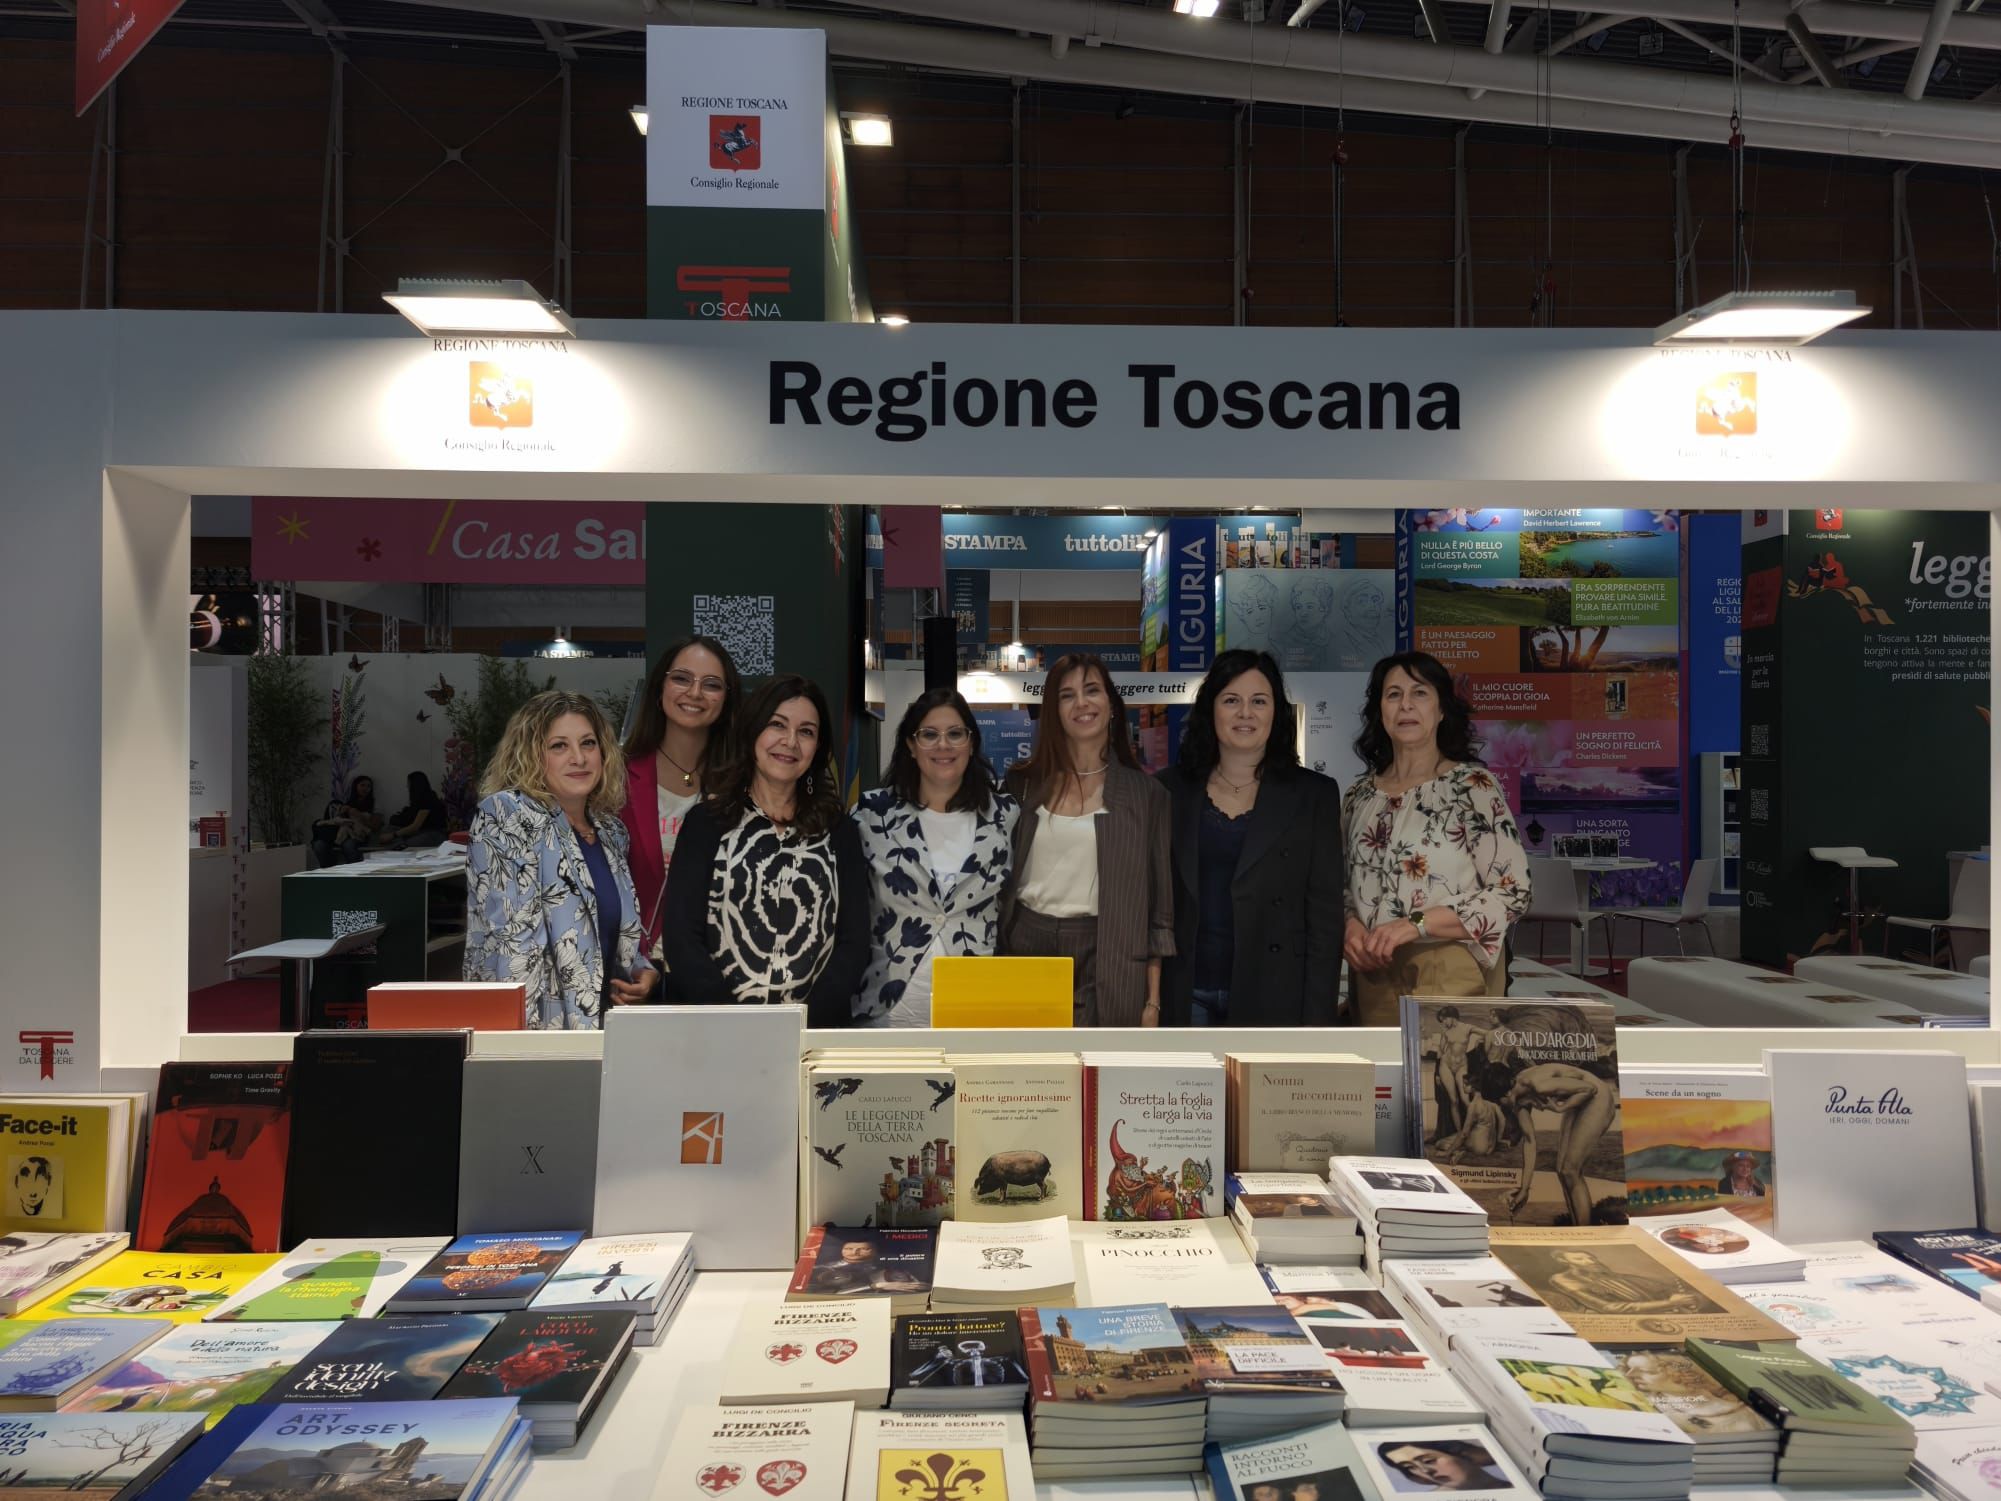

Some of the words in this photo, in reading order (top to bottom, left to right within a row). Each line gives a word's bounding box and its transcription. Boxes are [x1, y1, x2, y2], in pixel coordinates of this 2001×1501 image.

[681, 97, 733, 109] REGIONE
[736, 98, 788, 111] TOSCANA
[690, 177, 733, 191] Consiglio
[735, 178, 780, 191] Regionale
[686, 301, 782, 318] TOSCANA
[769, 360, 1097, 442] Regione
[1128, 364, 1460, 430] Toscana
[1523, 508, 1582, 517] IMPORTANTE
[451, 519, 561, 561] Casa
[944, 535, 1027, 551] STAMPA
[1420, 541, 1451, 550] NULLA
[1459, 540, 1474, 550] PIÙ
[1475, 541, 1503, 550] BELLO
[1420, 551, 1429, 560] DI
[1429, 551, 1468, 560] QUESTA
[1469, 551, 1499, 560] COSTA
[1575, 583, 1592, 592] ERA
[1593, 583, 1666, 592] SORPRENDENTE
[1179, 536, 1207, 670] LIGURIA
[1575, 593, 1616, 602] PROVARE
[1616, 593, 1637, 602] UNA
[1638, 593, 1666, 602] SIMILE
[1575, 603, 1600, 612] PURA
[1601, 602, 1660, 612] BEATITUDINE
[1443, 631, 1496, 639] PAESAGGIO
[1915, 635, 1938, 644] 1.221
[1421, 641, 1449, 649] FATTO
[1450, 641, 1467, 649] PER
[1935, 672, 1961, 681] salute
[1157, 681, 1187, 693] tutti
[1472, 683, 1480, 691] IL
[1480, 683, 1500, 691] MIO
[1502, 683, 1534, 691] CUORE
[1472, 692, 1511, 701] SCOPPIA
[1512, 692, 1520, 701] DI
[1523, 692, 1550, 701] GIOIA
[1576, 732, 1590, 740] UN
[1591, 732, 1636, 740] PERFETTO
[1576, 741, 1610, 750] SOGNO
[1612, 741, 1622, 750] DI
[1624, 740, 1662, 750] FELICITÀ
[1576, 819, 1596, 828] UNA
[1598, 819, 1629, 828] SORTA
[1494, 1031, 1534, 1048] SOGNI
[1262, 1073, 1304, 1087] Nonna
[959, 1092, 995, 1104] Ricette
[997, 1092, 1072, 1105] ignorantissime
[1290, 1091, 1363, 1102] raccontami
[1645, 1088, 1669, 1098] Scene
[1671, 1088, 1682, 1097] da
[1696, 1089, 1722, 1100] sogno
[1119, 1090, 1165, 1106] Stretta
[1167, 1090, 1178, 1106] la
[1179, 1091, 1213, 1111] foglia
[1824, 1086, 1874, 1115] Punta
[845, 1110, 858, 1121] LE
[862, 1110, 926, 1121] LEGGENDE
[1142, 1110, 1151, 1120] e
[1153, 1105, 1182, 1124] larga
[1183, 1106, 1193, 1120] la
[1195, 1109, 1213, 1120] via
[0, 1113, 78, 1137] Face-it
[847, 1121, 882, 1132] DELLA
[886, 1121, 924, 1132] TERRA
[1874, 1116, 1911, 1126] DOMANI
[857, 1132, 913, 1143] TOSCANA
[1450, 1168, 1484, 1178] Sigmund
[1485, 1169, 1518, 1180] Lipinsky
[1101, 1248, 1213, 1258] PINOCCHIO
[143, 1270, 223, 1280] CASA
[773, 1316, 858, 1326] BIZZARRA
[781, 1312, 853, 1320] FIRENZE
[1097, 1316, 1123, 1325] UNA
[1124, 1313, 1161, 1323] BREVE
[907, 1323, 951, 1333] Pronto
[294, 1379, 380, 1394] design
[288, 1413, 350, 1424] ART
[880, 1418, 940, 1428] FIRENZE
[944, 1420, 1006, 1428] SEGRETA
[275, 1422, 422, 1437] ODYSSEY
[721, 1420, 807, 1431] FIRENZE
[712, 1428, 812, 1439] BIZZARRA
[1231, 1441, 1309, 1463] RACCONTI
[1234, 1451, 1306, 1471] INTORNO
[1259, 1458, 1313, 1475] FUOCO
